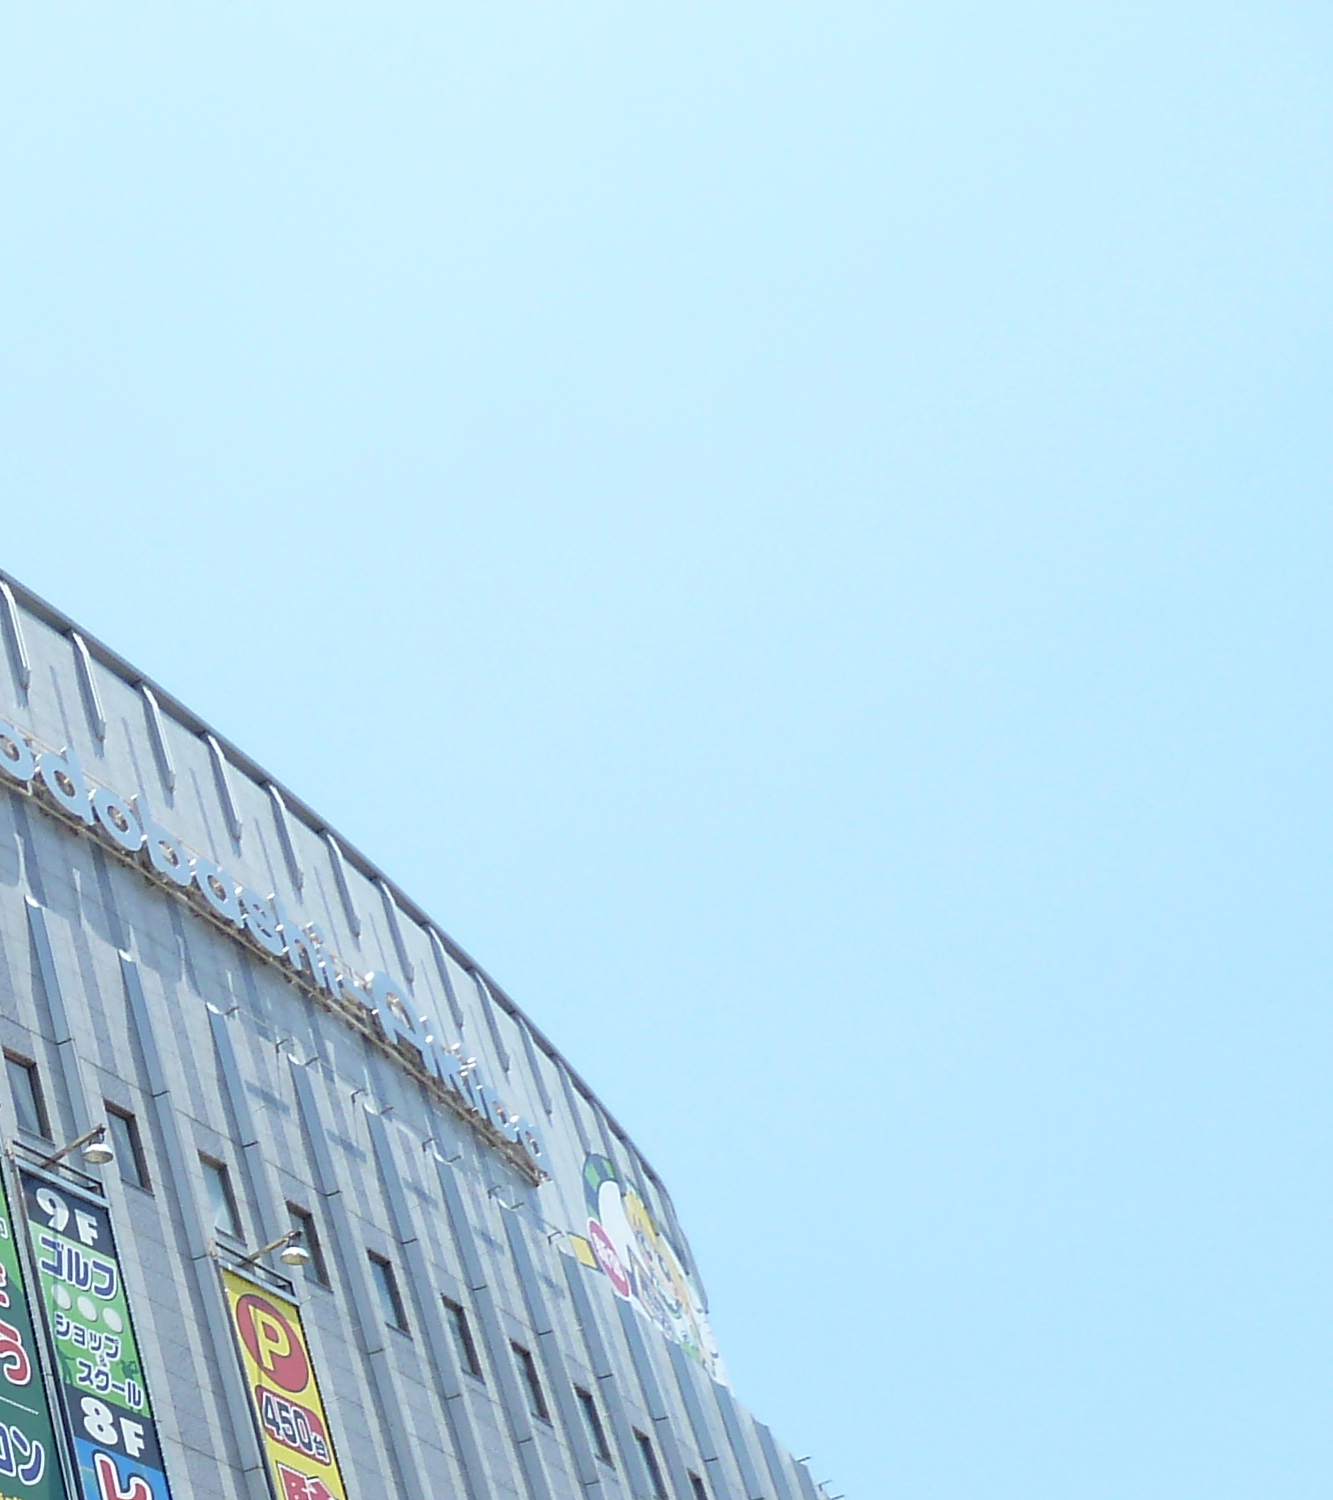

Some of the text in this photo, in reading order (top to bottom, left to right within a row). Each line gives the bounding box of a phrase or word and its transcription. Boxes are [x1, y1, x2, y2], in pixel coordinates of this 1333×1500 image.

[36, 1187, 99, 1246] 9F
[38, 1236, 118, 1300] ゴルフ
[247, 1303, 292, 1372] P
[77, 1359, 143, 1407] スクール
[80, 1396, 146, 1458] 8F
